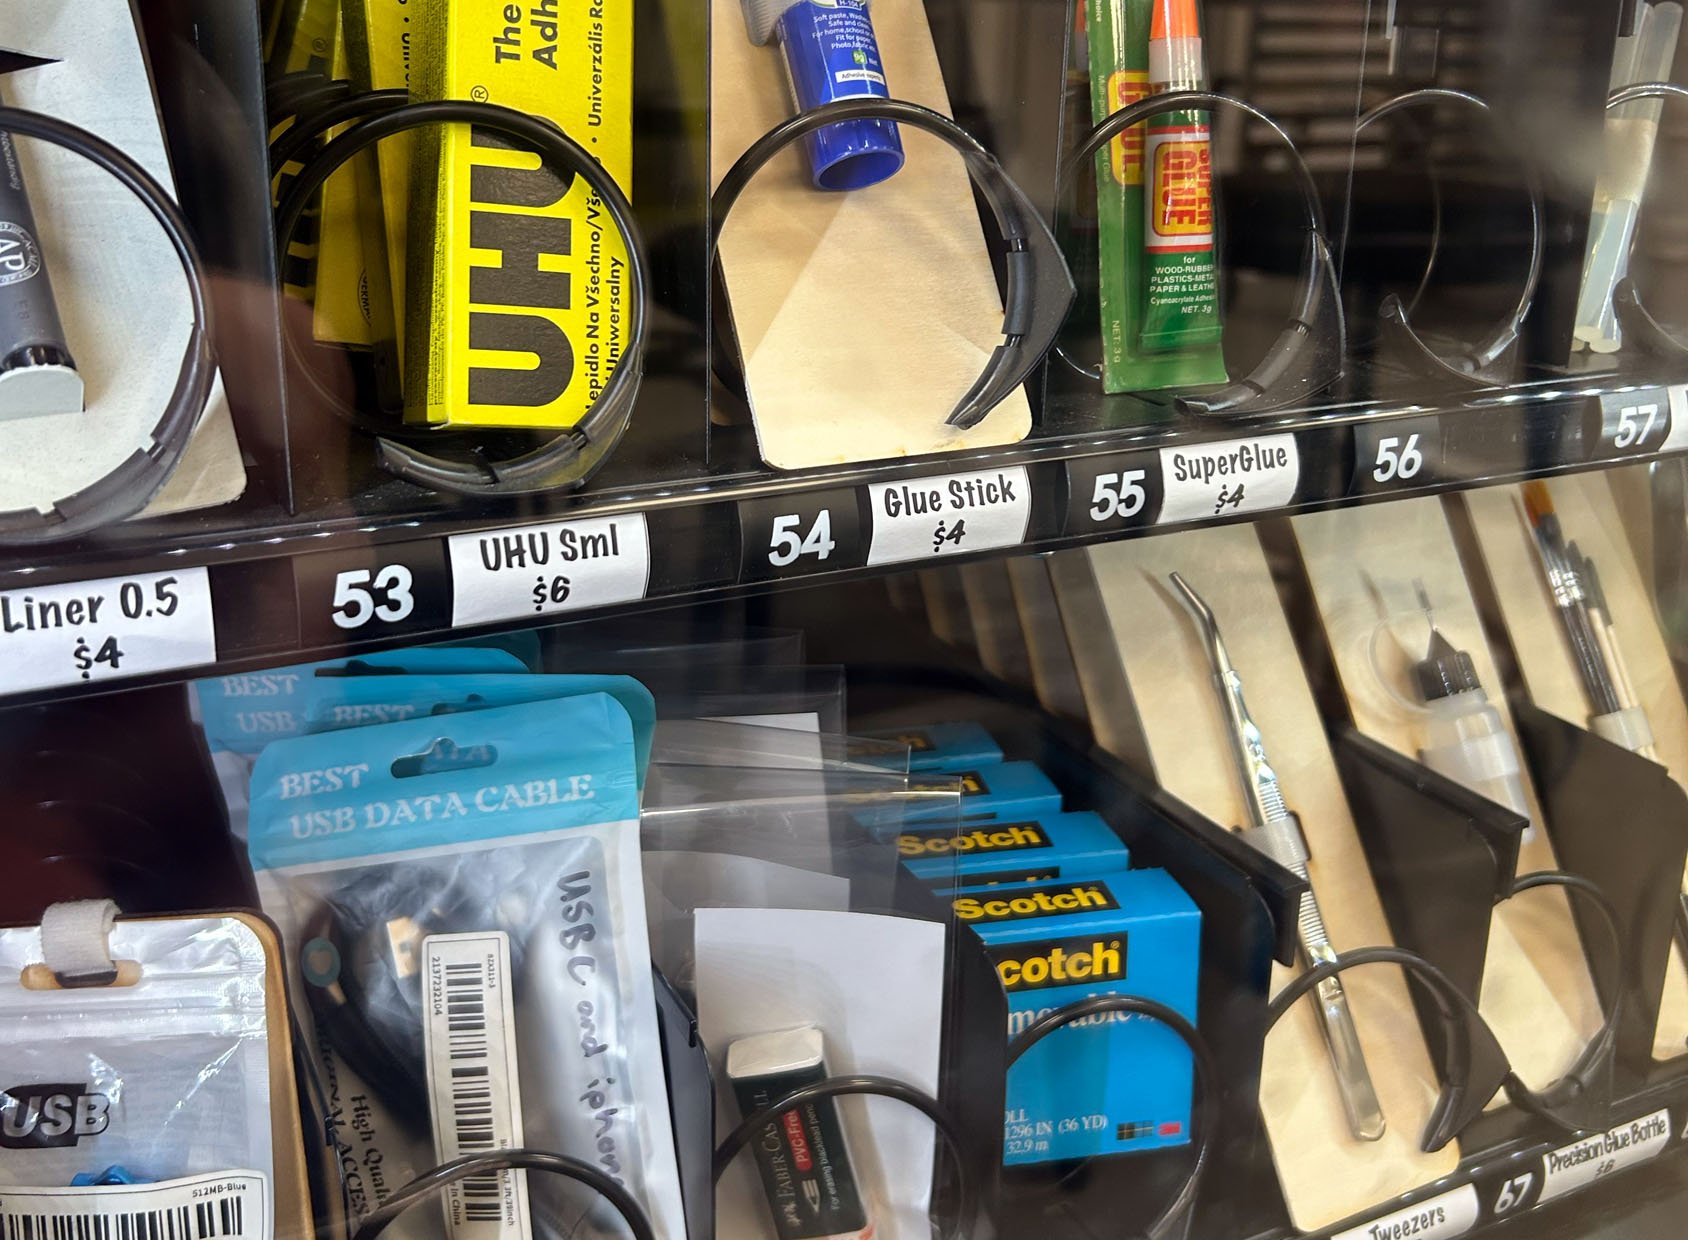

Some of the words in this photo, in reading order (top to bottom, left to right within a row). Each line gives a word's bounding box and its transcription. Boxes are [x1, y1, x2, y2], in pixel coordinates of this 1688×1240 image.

[493, 4, 522, 64] The
[588, 22, 603, 126] Univerzális
[1162, 150, 1198, 225] GLUE
[468, 114, 575, 407] UHU
[1183, 255, 1197, 264] for
[1150, 285, 1180, 293] PAPER
[1201, 304, 1213, 314] 3g
[586, 312, 600, 339] Na
[606, 256, 625, 368] Uniwersalny
[585, 354, 603, 410] epidlo
[1613, 403, 1659, 450] 57
[1173, 443, 1288, 485] SuperGlue
[1372, 433, 1423, 484] 56
[884, 486, 943, 518] Glue
[948, 474, 1017, 510] Stick
[1089, 469, 1146, 522] 55
[1214, 484, 1245, 515] $4
[479, 531, 550, 572] UHU
[559, 523, 620, 562] Sml
[768, 509, 836, 567] 54
[932, 519, 966, 553] $4
[0, 595, 105, 633] Liner
[120, 576, 179, 619] 0.5
[331, 564, 415, 629] 53
[532, 575, 571, 611] $6
[73, 635, 125, 679] $4
[222, 673, 299, 697] BEST
[236, 710, 298, 733] USB
[278, 763, 370, 800] BEST
[289, 807, 357, 840] USB
[363, 791, 468, 829] DATA
[474, 774, 597, 814] CABLE
[895, 826, 1041, 856] Scotch
[952, 887, 1108, 919] Scotch
[995, 941, 1121, 986] cotch
[1, 1092, 111, 1138] USB
[350, 1093, 376, 1143] High
[363, 1148, 391, 1204] Quali
[1547, 1140, 1604, 1175] Precision
[1603, 1130, 1631, 1154] Glue
[1630, 1115, 1667, 1145] Bottle
[1494, 1171, 1534, 1215] 67
[1368, 1206, 1446, 1240] Tweezers
